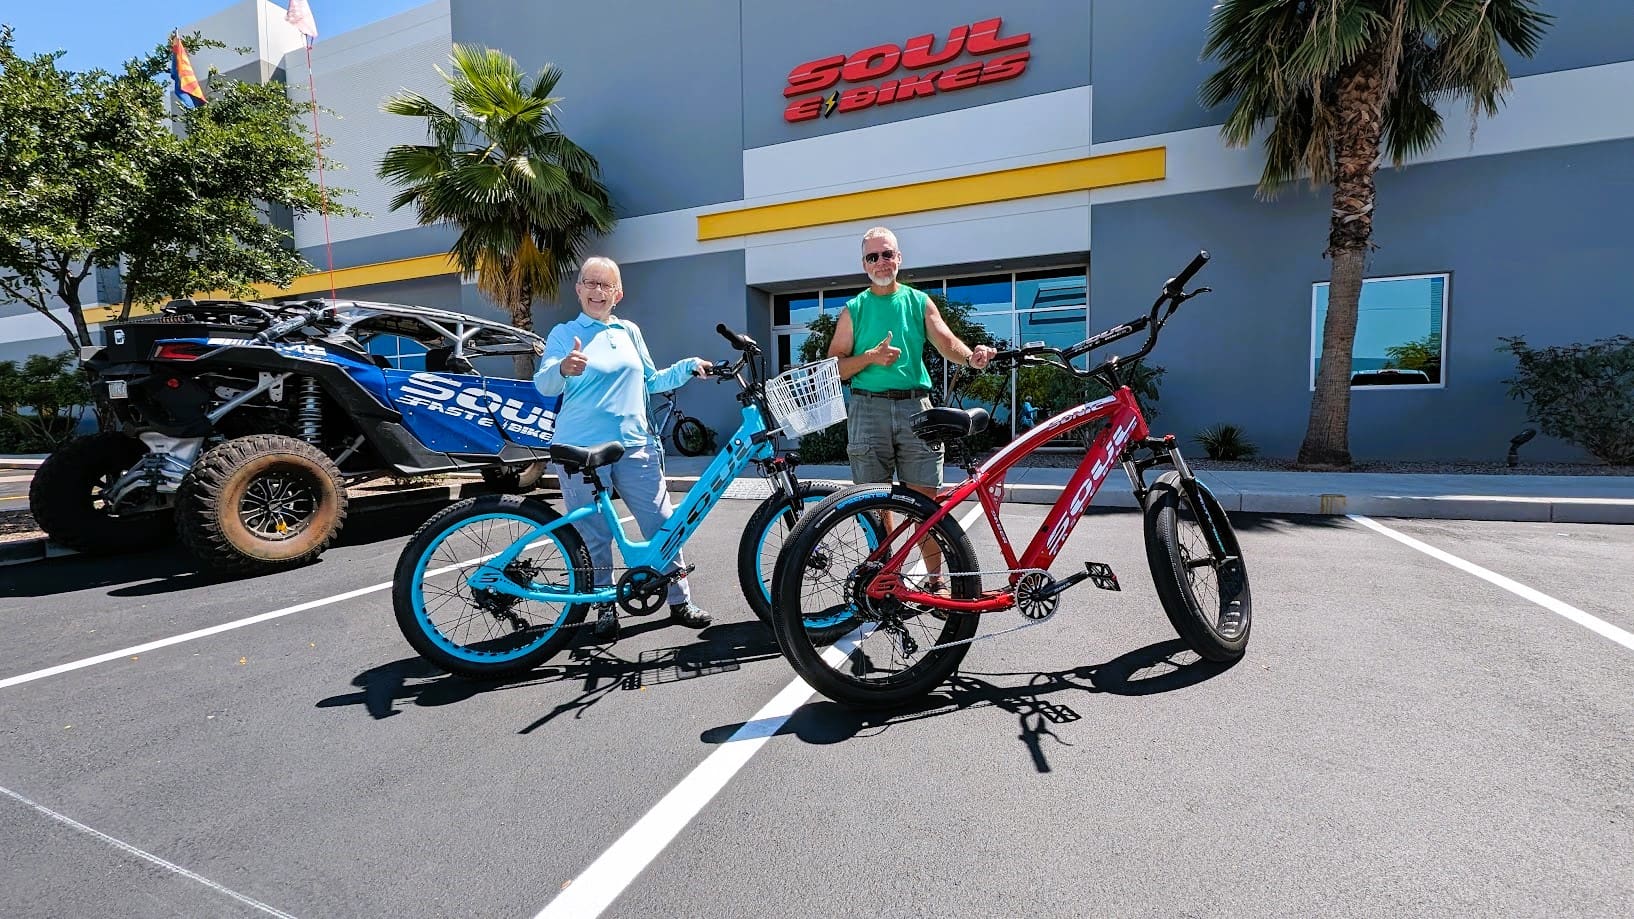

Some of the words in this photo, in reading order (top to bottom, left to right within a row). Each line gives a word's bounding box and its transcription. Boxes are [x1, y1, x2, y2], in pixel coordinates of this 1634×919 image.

[783, 16, 1031, 98] SOUL
[837, 51, 1031, 113] BIKES
[509, 423, 554, 443] BIKE
[1047, 402, 1104, 431] SONIC
[659, 443, 753, 560] SOUL
[1047, 415, 1137, 555] SOUL
